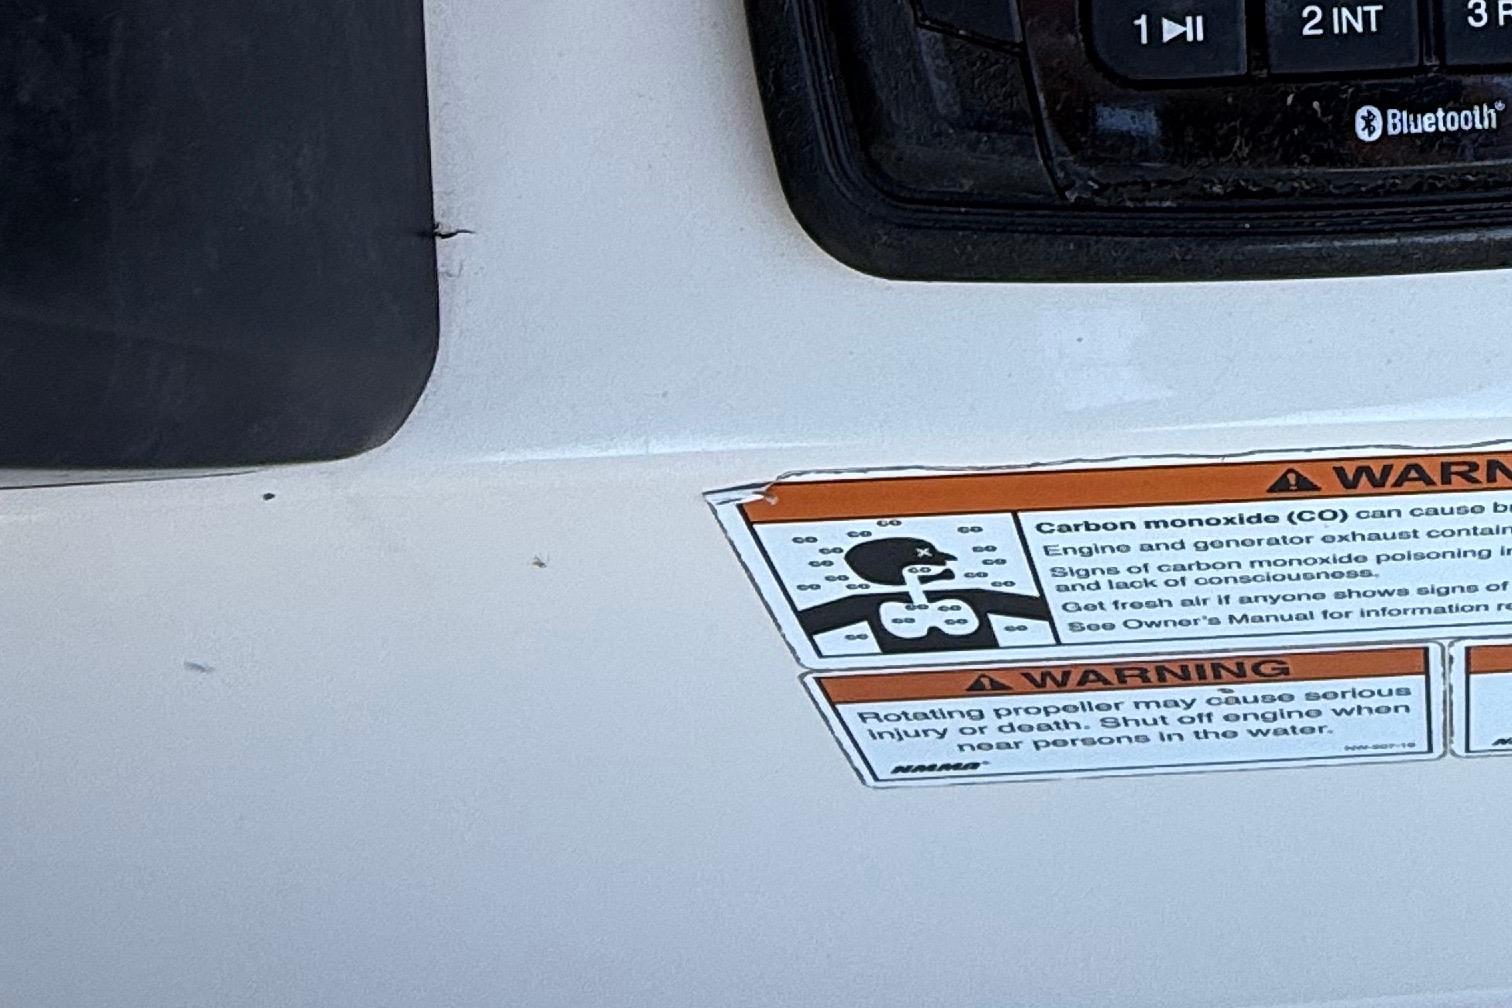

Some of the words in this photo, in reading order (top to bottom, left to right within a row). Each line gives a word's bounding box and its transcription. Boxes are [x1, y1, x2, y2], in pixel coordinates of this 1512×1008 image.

[1134, 14, 1148, 44] 1
[1301, 6, 1324, 36] 2
[1332, 5, 1383, 33] INT
[1035, 520, 1136, 534] Carbon
[1144, 512, 1280, 530] monoxide
[1288, 508, 1348, 525] (CO)
[1355, 507, 1402, 519] can
[1409, 503, 1485, 518] cause
[1043, 543, 1131, 559] Engine
[1140, 539, 1185, 553] and
[1193, 533, 1314, 552] generator
[1321, 528, 1419, 544] exhaust
[1049, 564, 1118, 580] Signs
[1127, 563, 1149, 574] of
[1157, 558, 1242, 573] carbon
[1250, 552, 1368, 568] monoxide
[1375, 546, 1492, 564] poisoning
[1055, 580, 1101, 593] and
[1108, 577, 1157, 591] lack
[1164, 575, 1186, 587] of
[1194, 568, 1379, 586] consciousness.
[1061, 600, 1105, 613] Get
[1112, 596, 1173, 611] fresh
[1180, 594, 1210, 607] air
[1218, 594, 1231, 605] if
[1239, 590, 1326, 606] anyone
[1334, 586, 1410, 600] shows
[1416, 582, 1479, 598] signs
[1485, 581, 1508, 592] of
[1068, 620, 1116, 632] See
[1122, 614, 1221, 630] Owner's
[1228, 610, 1315, 625] Manual
[1322, 608, 1352, 620] for
[1359, 599, 1491, 619] information
[1022, 658, 1291, 689] WARNING
[857, 707, 985, 724] Rotating
[992, 700, 1125, 719] propeller
[1134, 697, 1197, 711] may
[1206, 693, 1295, 706] cause
[1304, 686, 1412, 700] serious
[868, 727, 948, 742] injury
[959, 724, 988, 736] or
[998, 720, 1090, 733] death.
[1100, 715, 1169, 728] Shut
[1177, 712, 1213, 725] off
[1223, 708, 1323, 723] engine
[1331, 703, 1410, 716] when
[957, 739, 1022, 752] near
[1032, 733, 1150, 750] persons
[1159, 730, 1185, 742] in
[1194, 728, 1238, 740] the
[1246, 723, 1334, 737] water.
